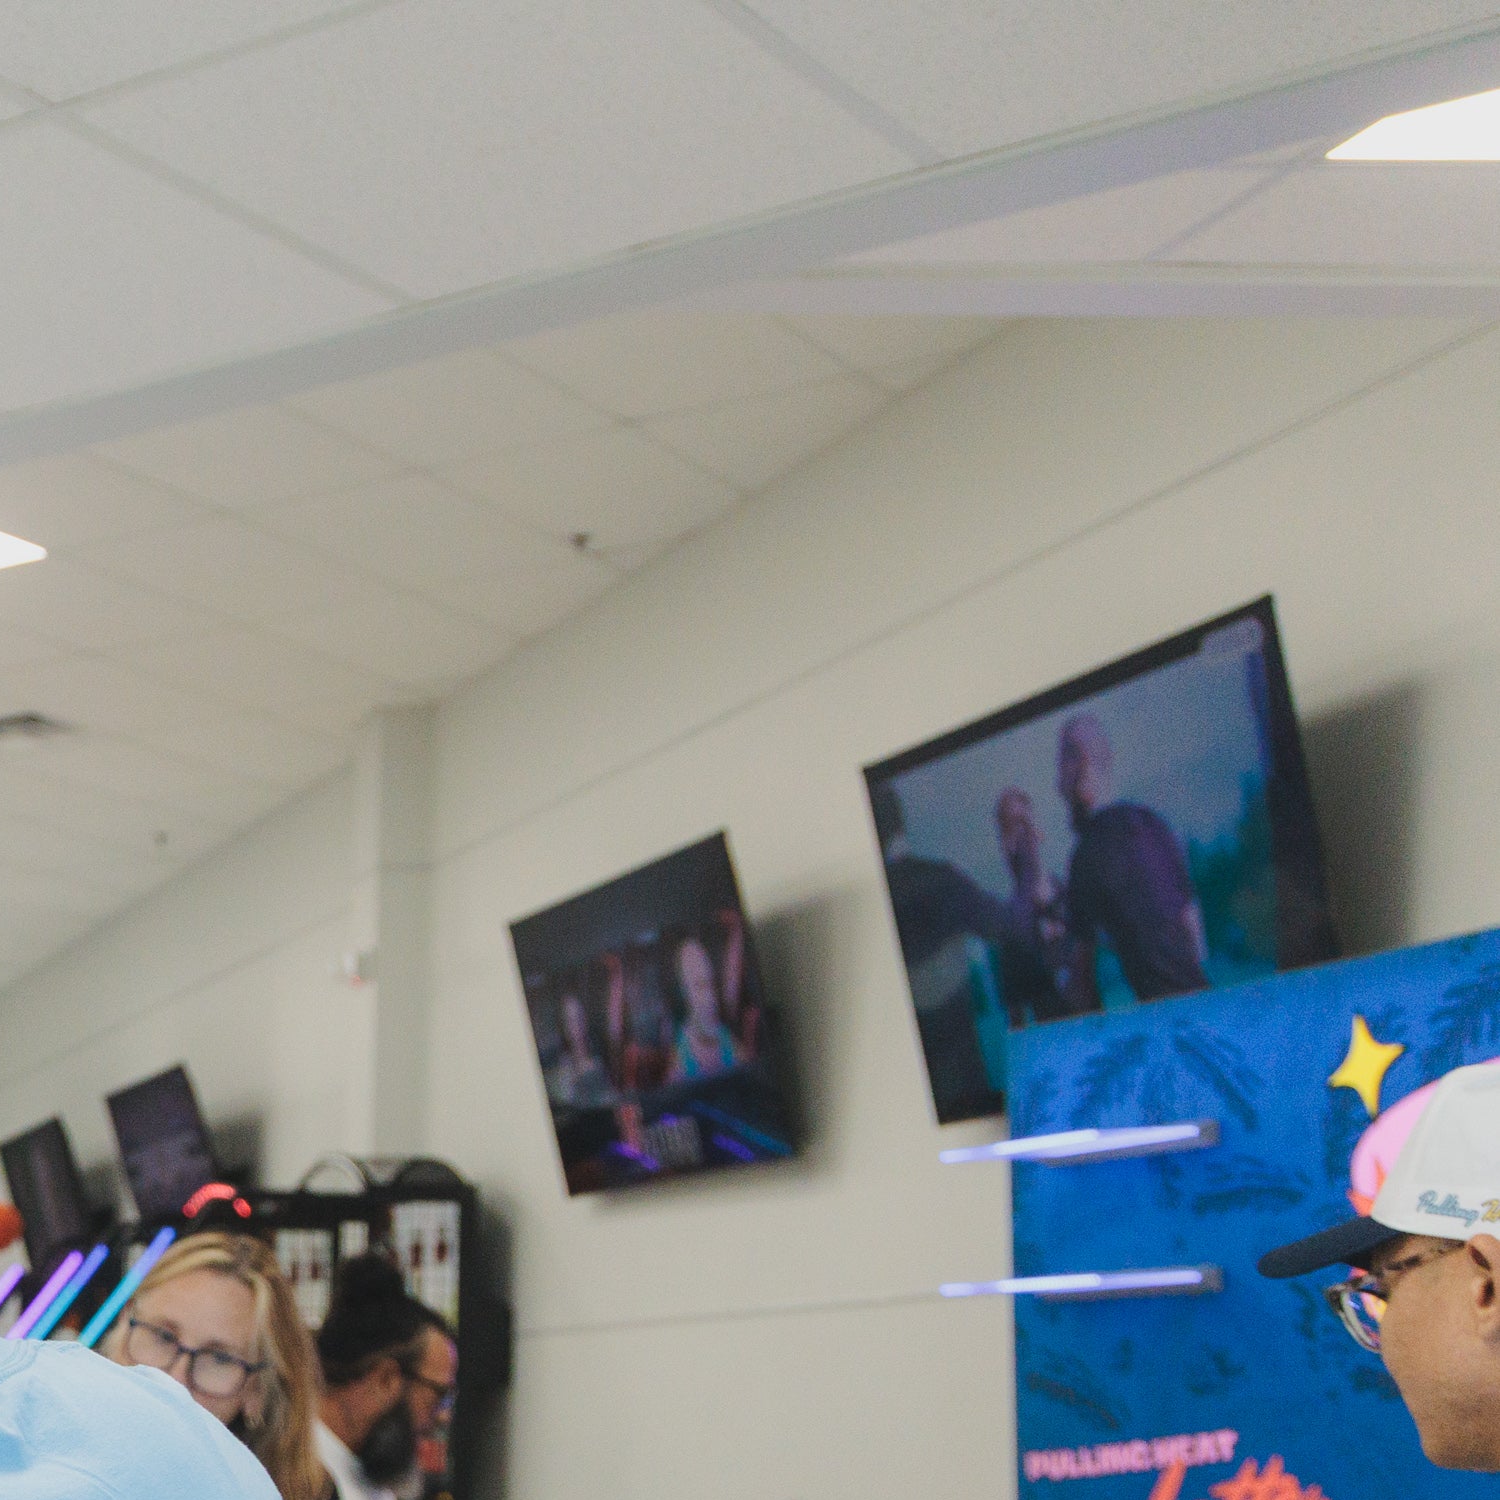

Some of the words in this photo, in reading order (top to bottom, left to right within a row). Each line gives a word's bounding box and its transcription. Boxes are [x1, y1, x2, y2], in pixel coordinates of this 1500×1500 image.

[1416, 1190, 1480, 1228] Pulling
[1024, 1438, 1151, 1482] PULLING
[1152, 1428, 1238, 1468] HEAT
